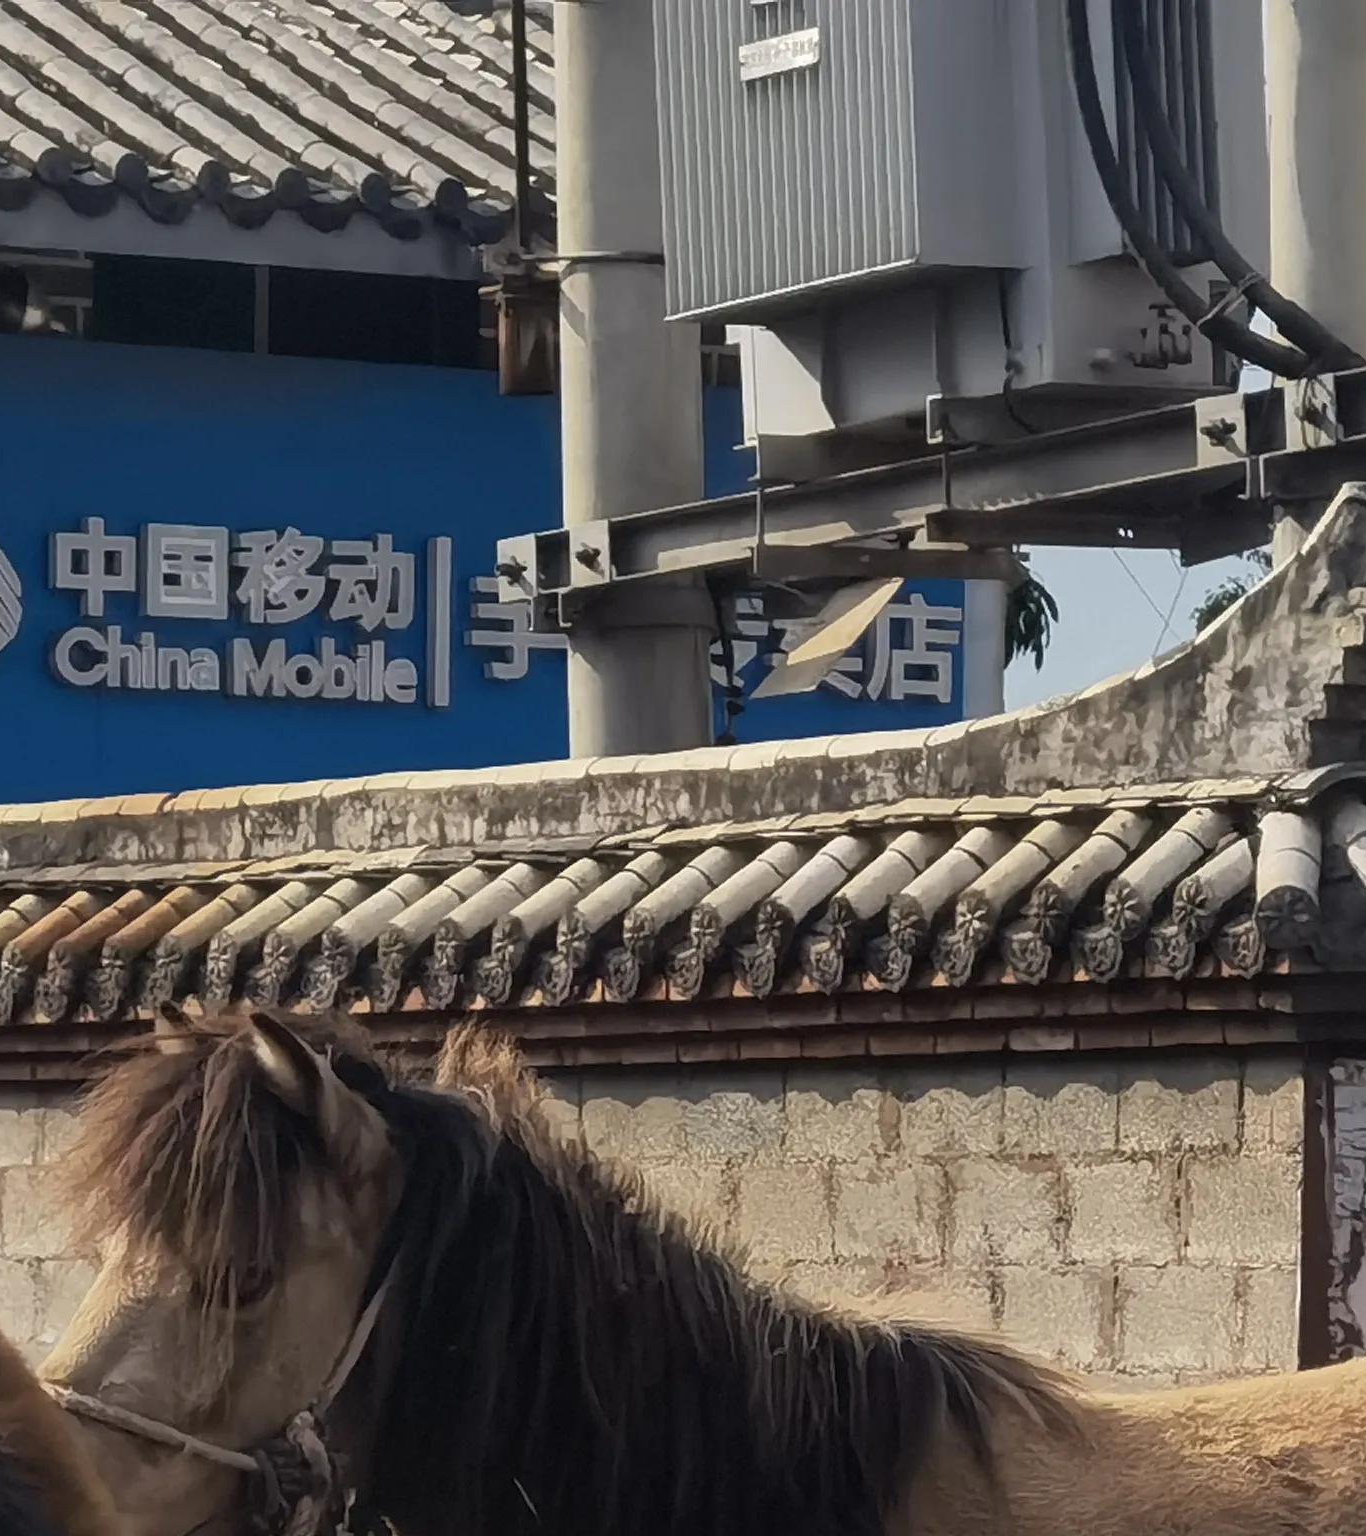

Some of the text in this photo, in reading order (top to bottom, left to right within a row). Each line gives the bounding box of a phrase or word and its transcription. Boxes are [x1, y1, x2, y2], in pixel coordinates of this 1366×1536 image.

[50, 516, 415, 632] 中国移动
[54, 625, 417, 704] China Mobile
